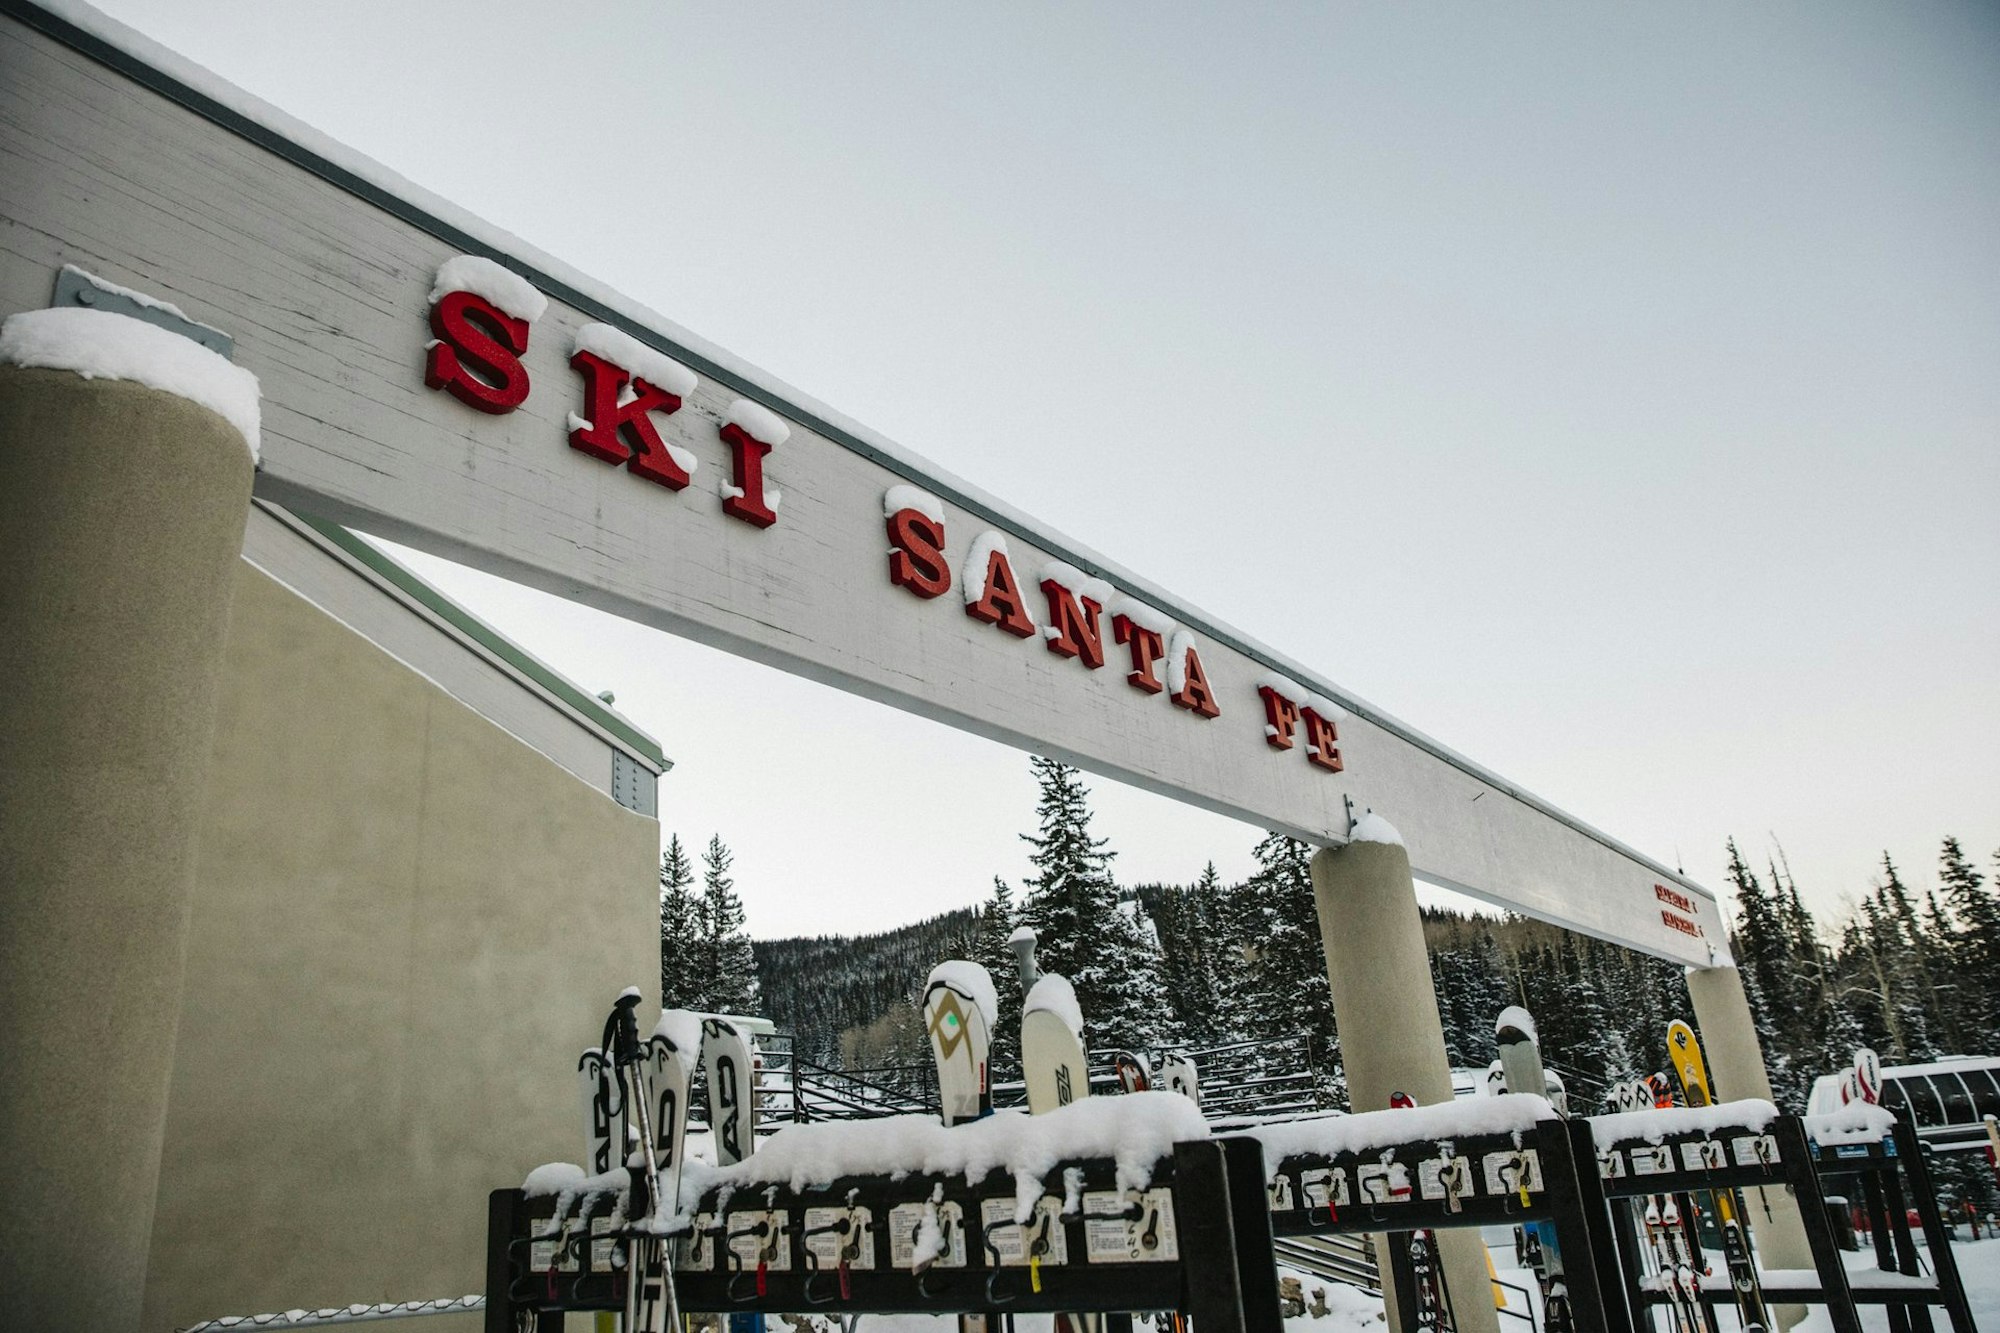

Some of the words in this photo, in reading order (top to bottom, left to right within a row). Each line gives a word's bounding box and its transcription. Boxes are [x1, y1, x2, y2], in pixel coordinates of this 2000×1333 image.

[425, 290, 777, 529] SKI
[887, 507, 1221, 719] SANTA
[1257, 685, 1344, 773] FE
